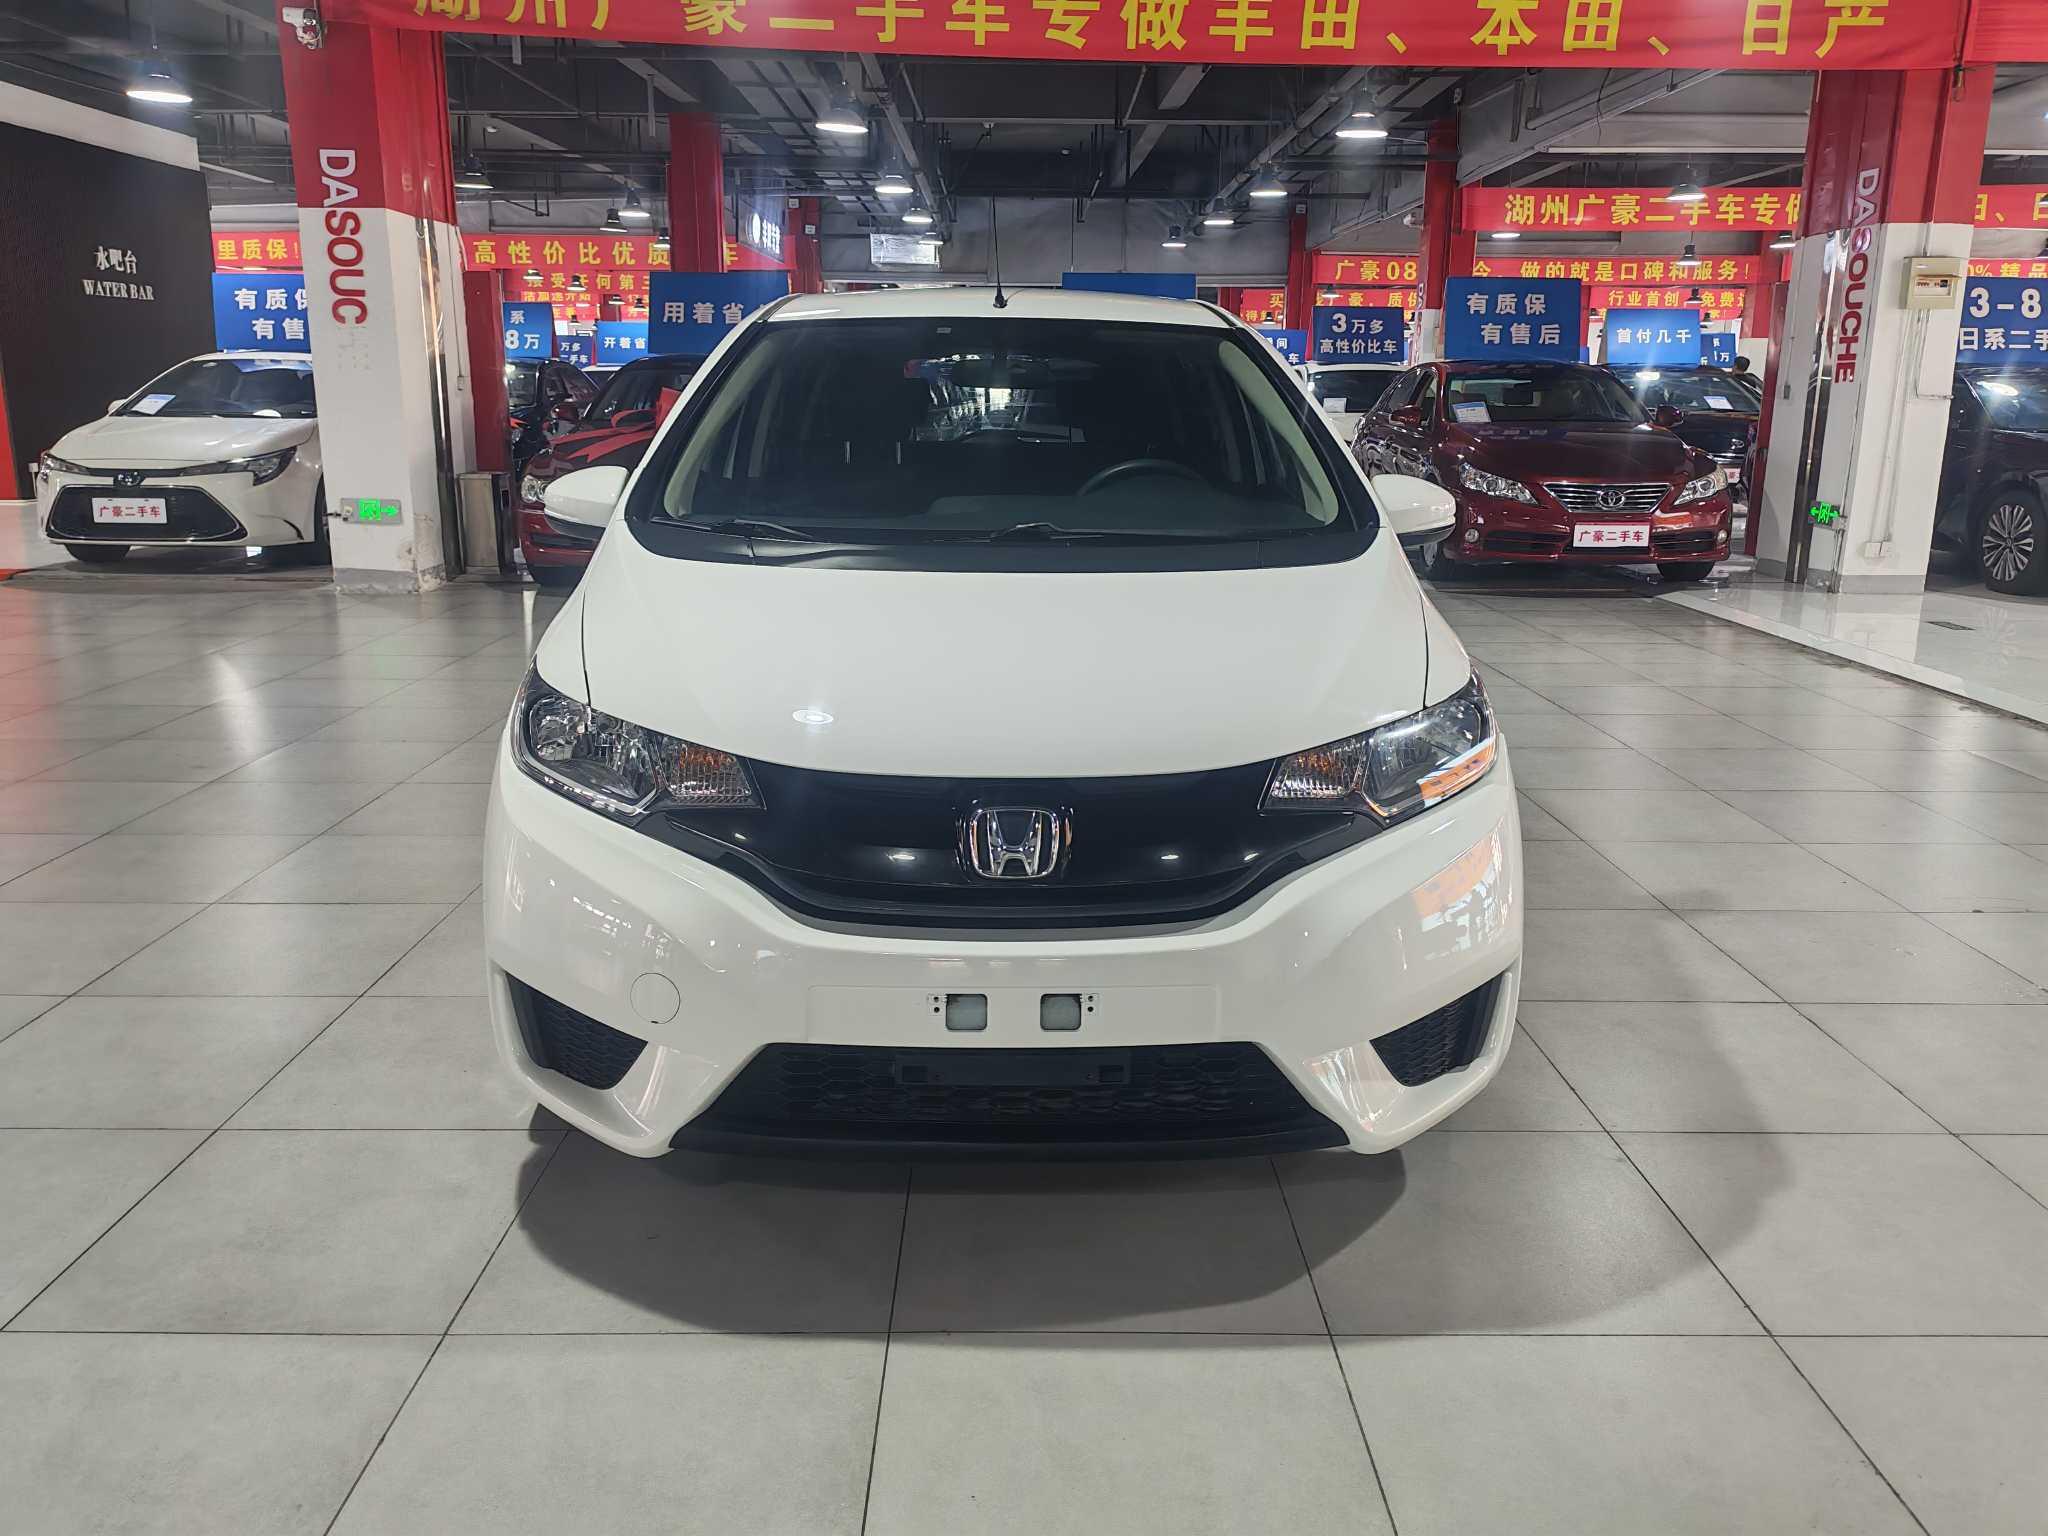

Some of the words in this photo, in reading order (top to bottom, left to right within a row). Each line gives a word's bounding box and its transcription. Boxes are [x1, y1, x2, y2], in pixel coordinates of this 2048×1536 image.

[412, 0, 1890, 59] 豪手车专做丰田、本田、日产
[93, 246, 137, 274] 水吧台
[1834, 167, 1880, 384] DASOUCHE
[82, 279, 128, 298] WATER
[129, 284, 155, 301] BAR
[1466, 294, 1546, 315] 有质保
[1331, 313, 1384, 334] 3万多
[1481, 323, 1561, 345] 有售后
[1616, 328, 1692, 344] 首付几千
[1319, 339, 1398, 355] 高性价比车
[98, 505, 161, 518] 广豪二手车
[1577, 529, 1645, 543] 广豪二手车
